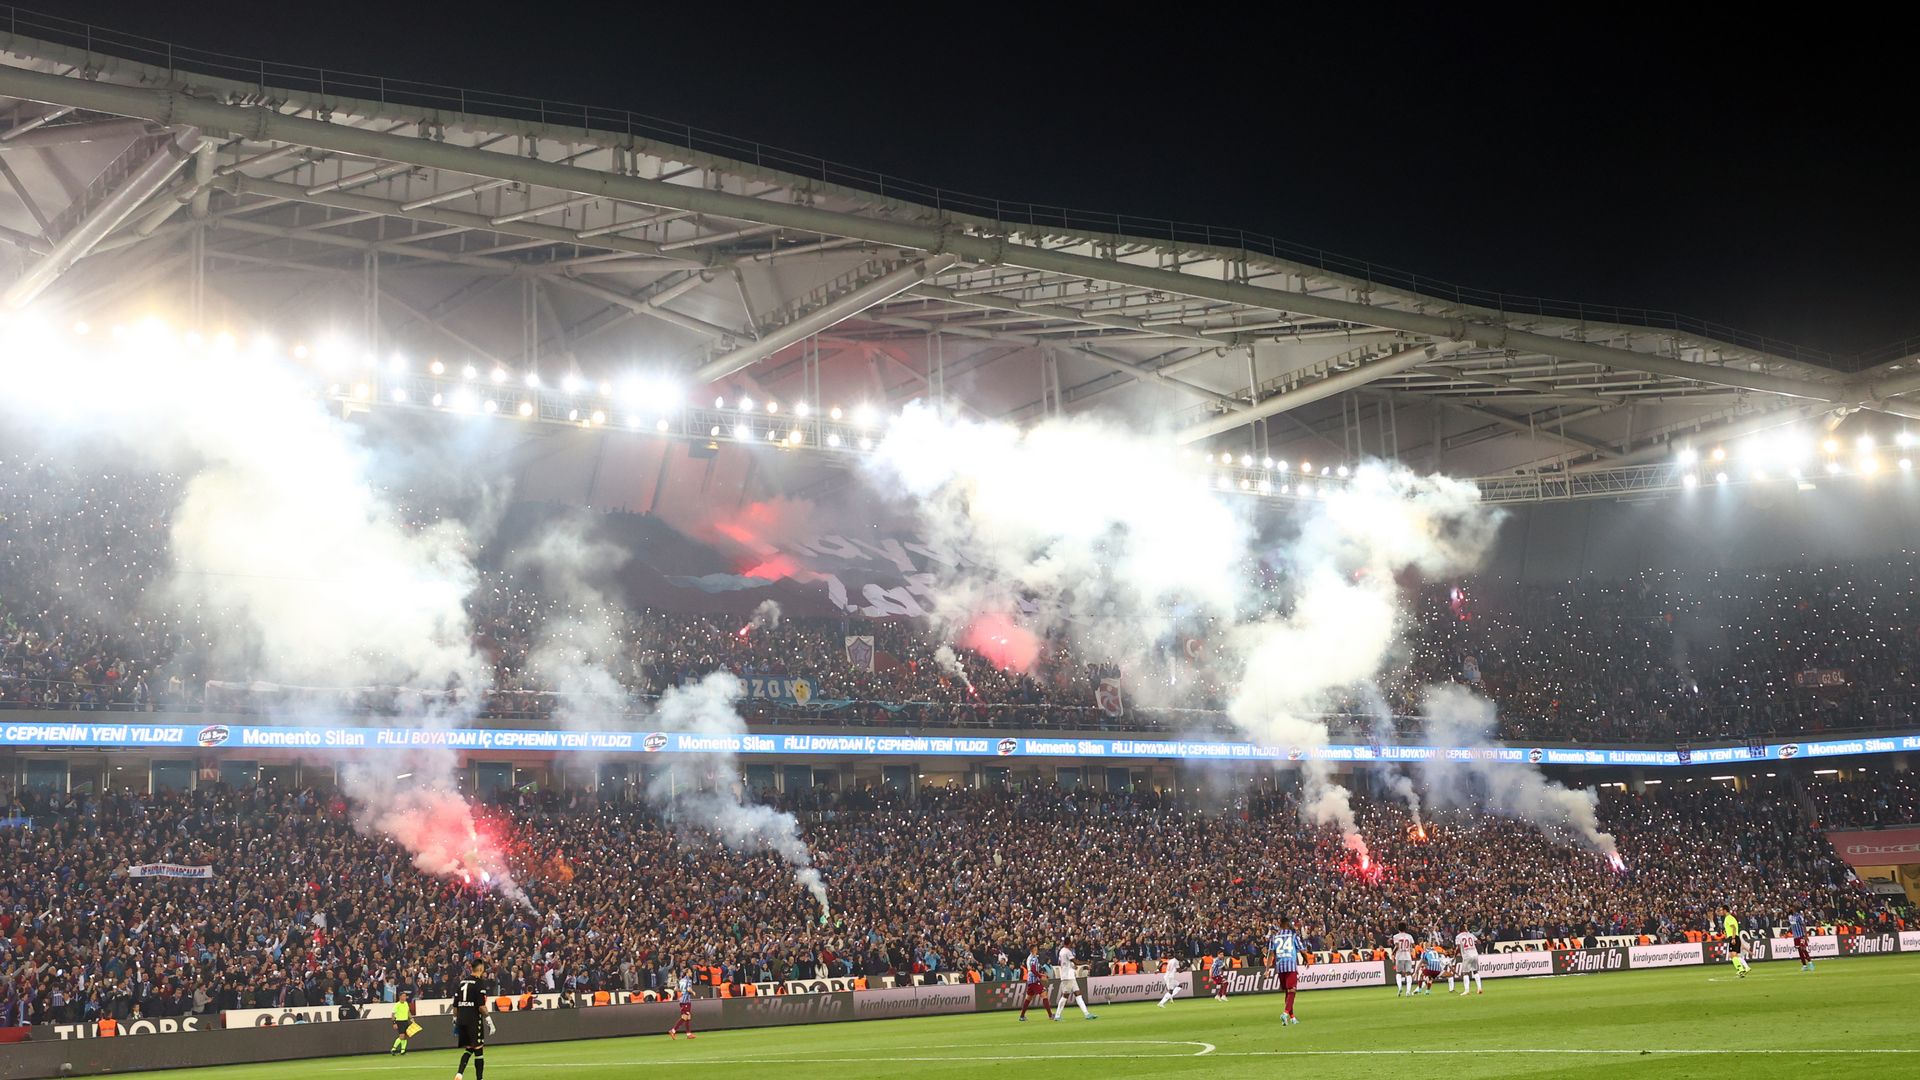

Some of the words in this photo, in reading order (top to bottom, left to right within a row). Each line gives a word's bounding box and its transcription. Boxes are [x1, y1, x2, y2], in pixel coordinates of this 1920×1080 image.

[5, 725, 88, 741] CEPHENİN
[92, 725, 127, 742] YENİ
[131, 729, 183, 743] YILDIZI
[243, 729, 321, 744] Momento
[325, 730, 364, 745] Silan
[377, 728, 409, 744] FİLLİ
[412, 731, 476, 746] BOYA'DAN
[479, 729, 493, 748] İÇ
[495, 731, 558, 747] CEPHENİN
[561, 731, 588, 747] YENİ
[591, 735, 632, 748] YILDIZI
[679, 736, 740, 750] Momento
[743, 736, 774, 750] Silan
[784, 735, 811, 750] FİLLİ
[812, 738, 863, 751] BOYA'DAN
[865, 736, 876, 753] İÇ
[877, 737, 927, 752] CEPHENİN
[930, 737, 953, 752] YENİ
[955, 740, 988, 752] YILDIZI
[1026, 740, 1076, 754] Momento
[1078, 740, 1104, 754] Silan
[1112, 740, 1133, 753] FİLLİ
[1134, 742, 1176, 755] BOYA'DAN
[1178, 741, 1187, 757] İÇ
[1188, 741, 1229, 756] CEPHENİN
[1231, 742, 1250, 756] YENİ
[1252, 745, 1279, 757] YILDIZI
[1808, 742, 1863, 756] Momento
[1865, 739, 1894, 751] Silan
[1310, 746, 1353, 759] Momento
[1382, 745, 1399, 758] FİLLİ
[1400, 748, 1436, 759] BOYA'DAN
[1482, 748, 1498, 760] YENİ
[1499, 750, 1522, 760] YILDIZI
[1548, 750, 1584, 763] Momento
[1586, 750, 1605, 763] Silan
[1609, 750, 1625, 763] FİLLİ
[1625, 752, 1656, 763] BOYA'DAN
[1657, 750, 1663, 766] İÇ
[1664, 750, 1708, 763] CEPNİN
[1710, 749, 1732, 761] YENİ
[1735, 747, 1768, 760] YILI
[1275, 937, 1293, 954] 24
[1399, 938, 1410, 950] 70
[1462, 937, 1474, 948] 20
[1752, 940, 1766, 959] Go
[1808, 943, 1836, 953] gidiyorum
[1858, 936, 1882, 953] Rent
[1882, 934, 1895, 951] Go
[1578, 951, 1607, 971] Rent
[1607, 948, 1623, 969] Go
[1632, 952, 1667, 963] kiralıyorum
[1669, 950, 1700, 962] gidiyorum
[1515, 959, 1549, 972] gidiyorum
[1226, 971, 1261, 992] Rent
[1262, 970, 1281, 991] Go
[1342, 966, 1380, 983] gidiyorum
[461, 984, 468, 1001] 1
[1093, 981, 1143, 997] kiralıyorum
[921, 993, 970, 1010] gidiyorum
